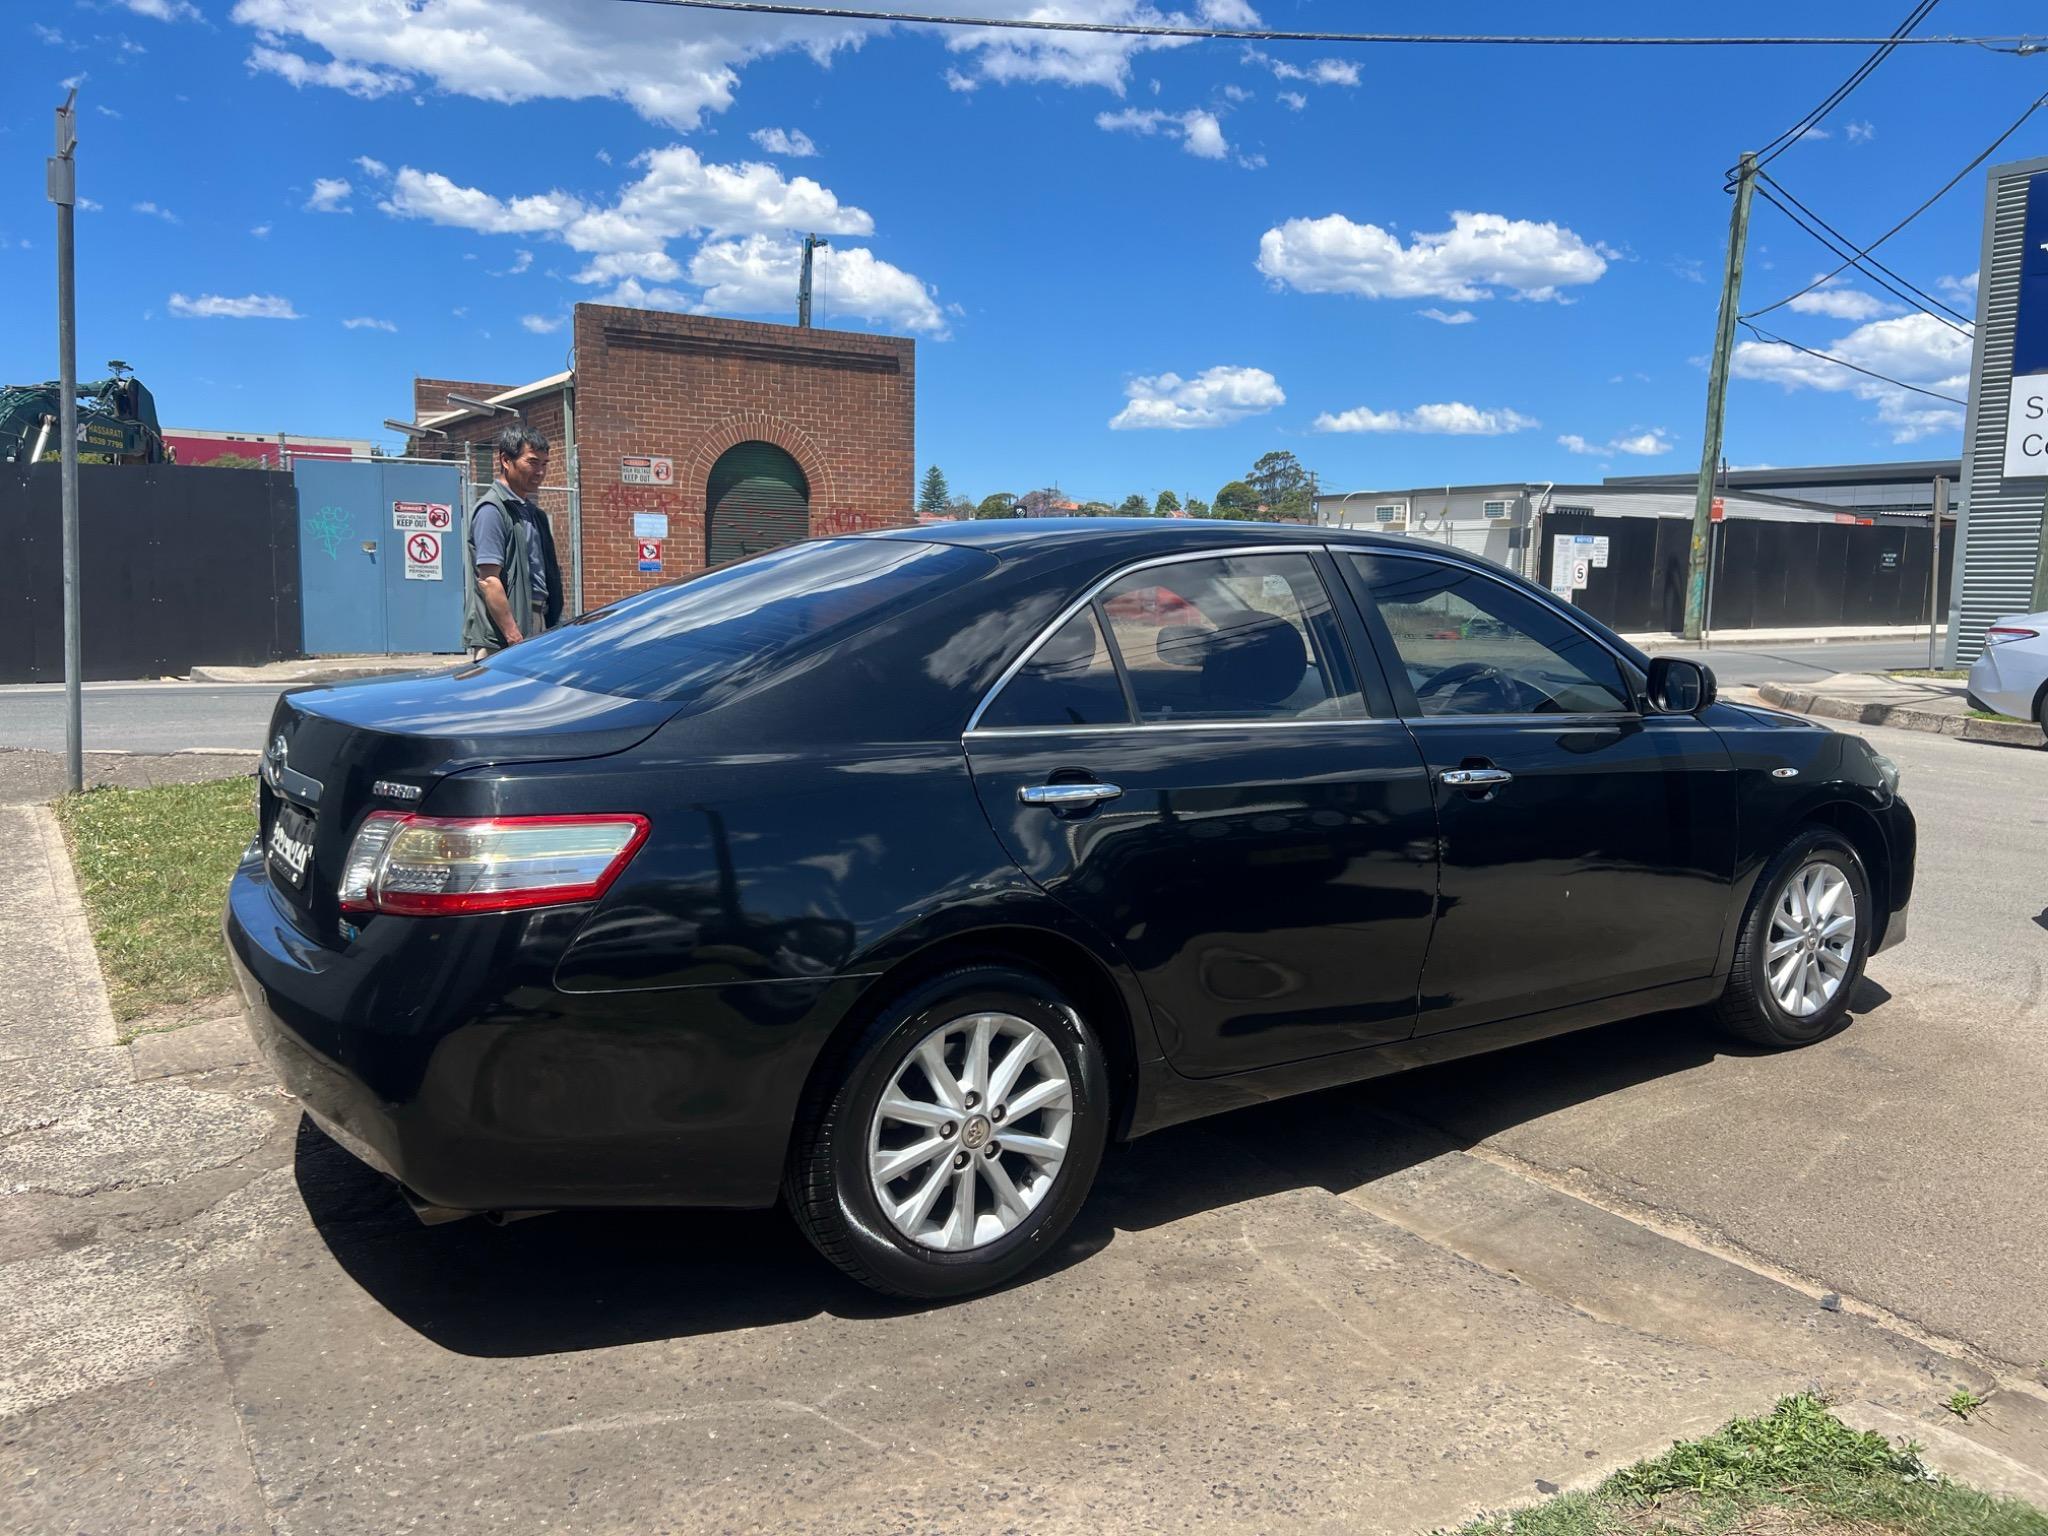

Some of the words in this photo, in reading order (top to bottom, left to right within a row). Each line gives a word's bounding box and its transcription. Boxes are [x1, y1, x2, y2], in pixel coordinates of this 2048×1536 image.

[2025, 396, 2048, 420] S
[2022, 433, 2048, 457] C
[624, 473, 639, 481] KEEP
[639, 474, 650, 483] OUT
[397, 519, 413, 527] KEEP
[414, 520, 427, 528] OUT
[1577, 567, 1584, 579] 5
